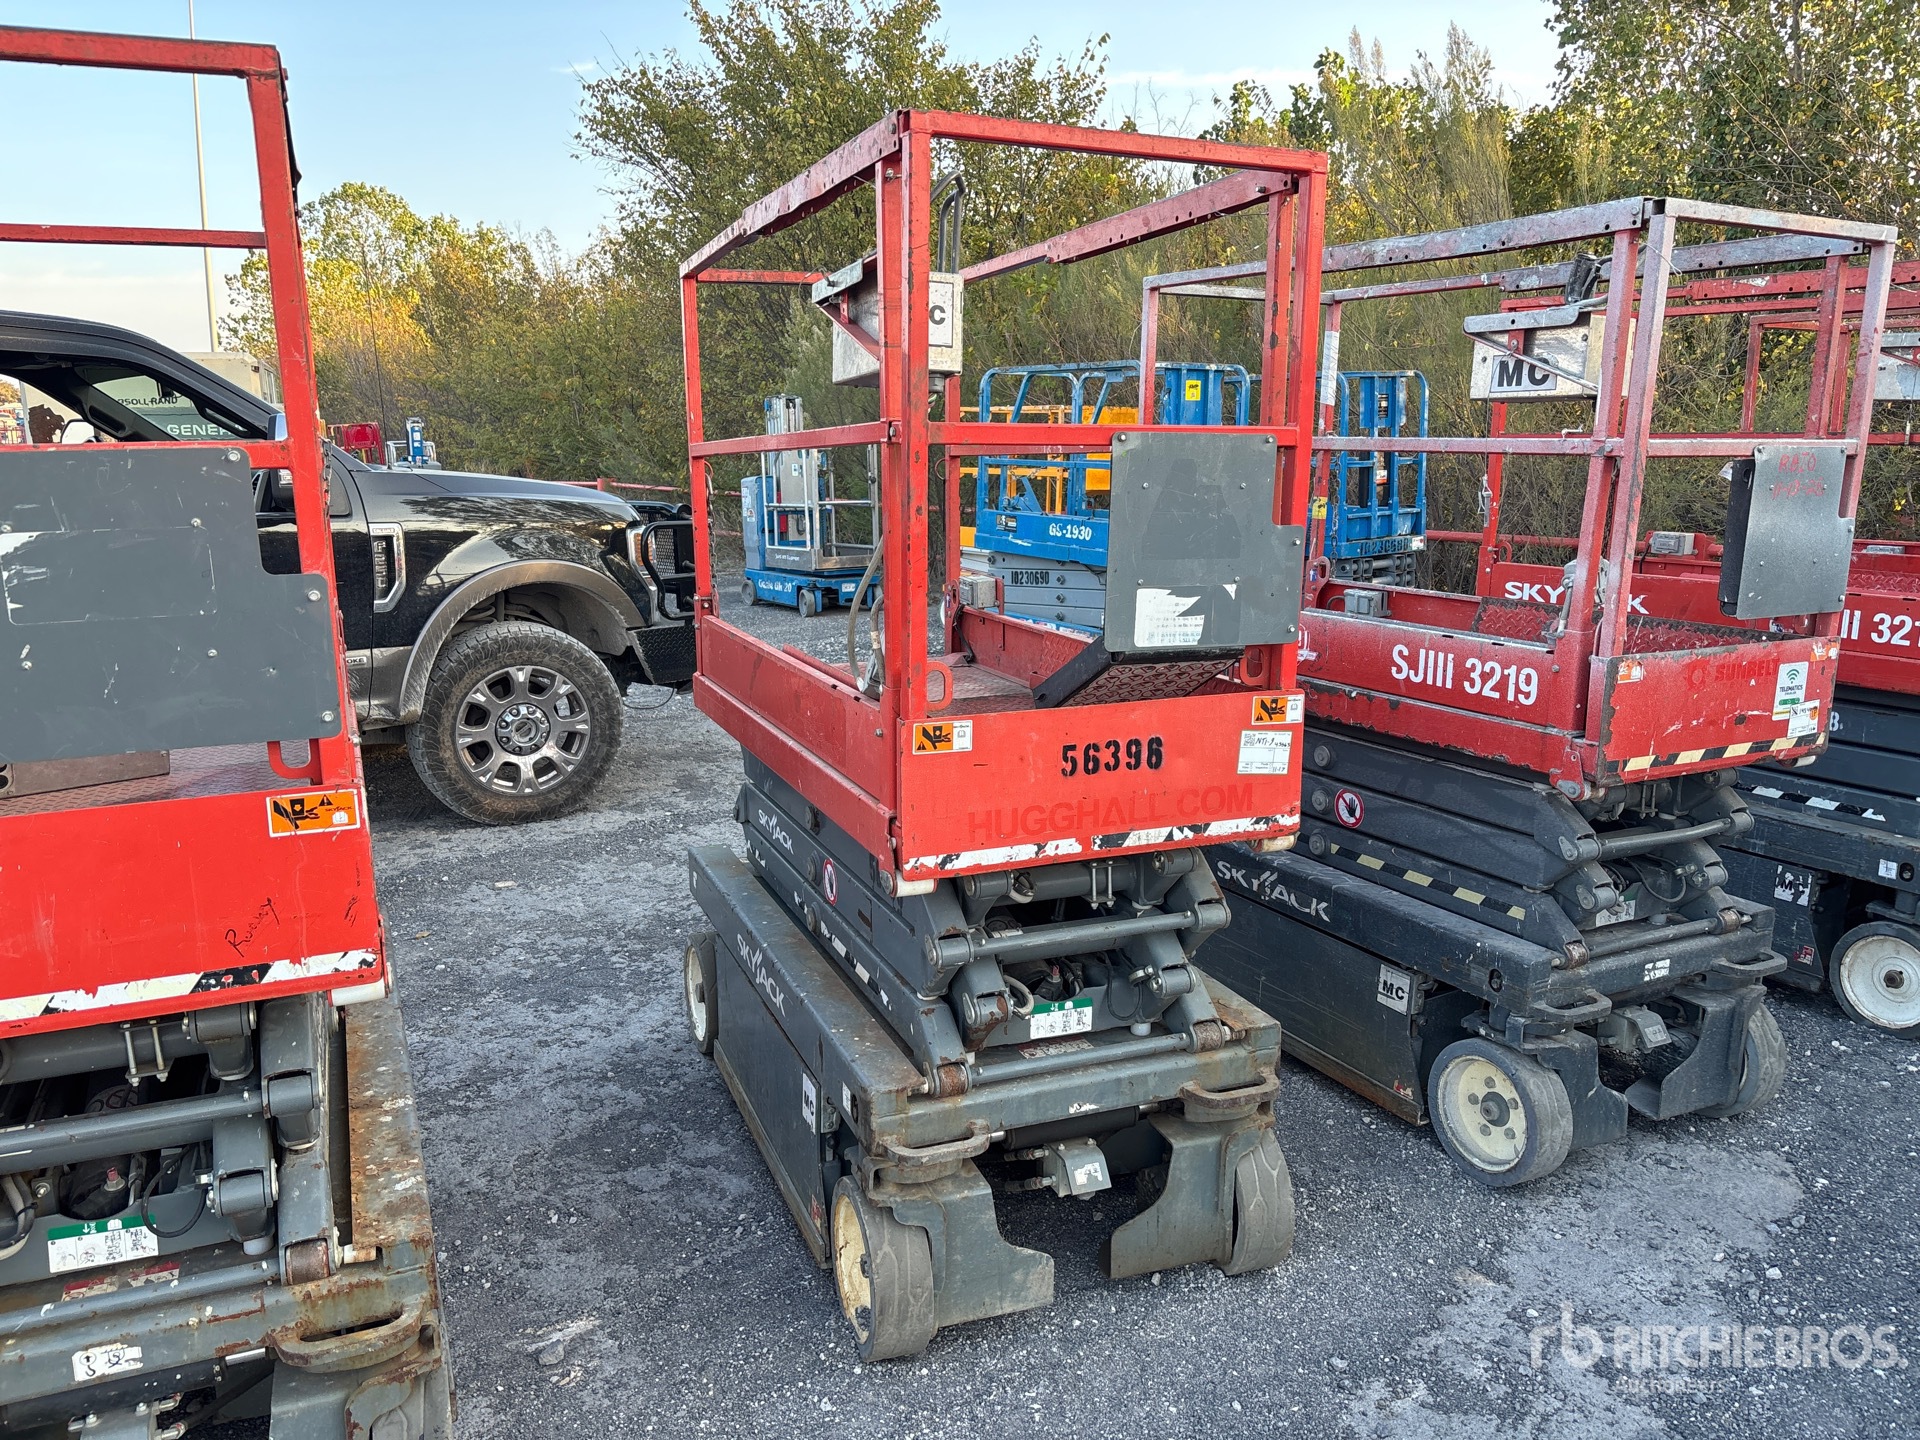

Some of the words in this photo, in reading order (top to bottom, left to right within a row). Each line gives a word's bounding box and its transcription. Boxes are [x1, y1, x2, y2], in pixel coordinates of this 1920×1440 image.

[928, 304, 946, 326] C
[1497, 357, 1551, 388] MC
[1048, 522, 1093, 541] GS-1930
[1504, 581, 1650, 615] SKYK
[1390, 644, 1455, 689] SJIII
[1463, 657, 1539, 707] 3219
[1060, 736, 1164, 777] 56396
[758, 808, 795, 855] SKYJACK
[1216, 860, 1331, 923] SKYJACK
[737, 932, 786, 1018] SKYJACK
[1382, 979, 1405, 1001] MC
[803, 1089, 815, 1117] MC
